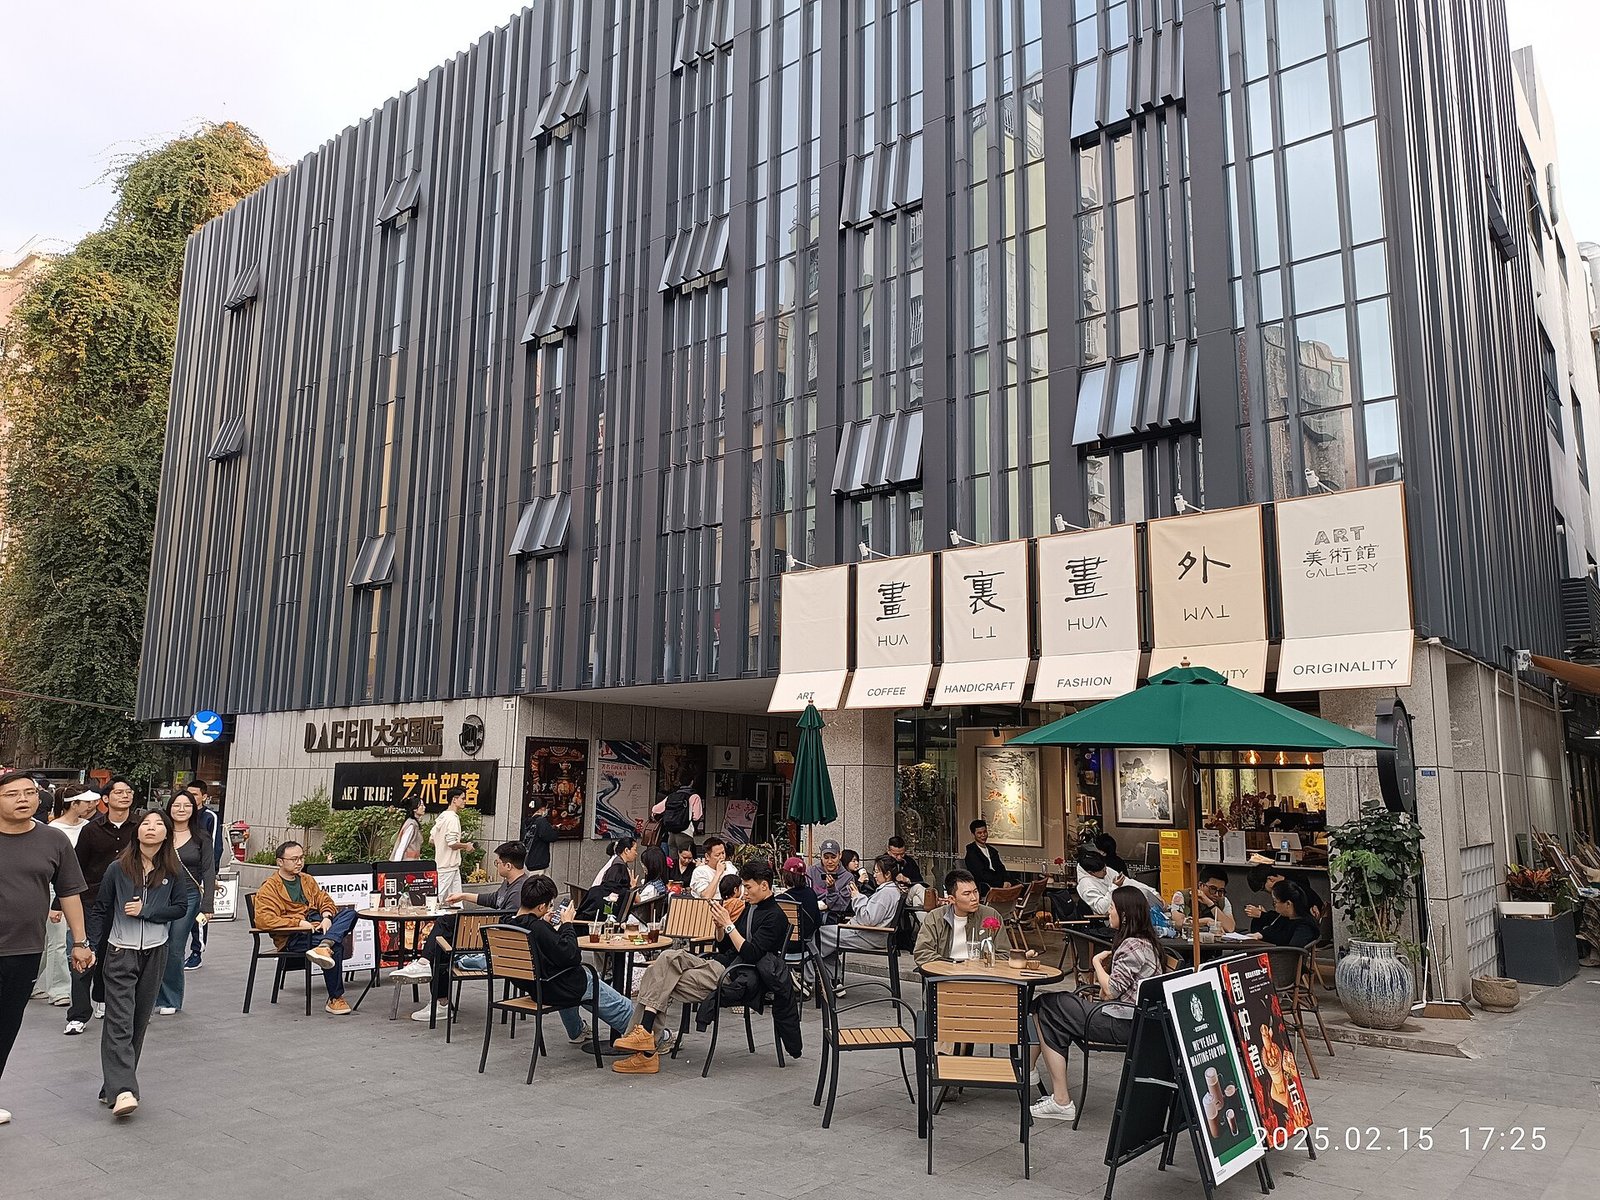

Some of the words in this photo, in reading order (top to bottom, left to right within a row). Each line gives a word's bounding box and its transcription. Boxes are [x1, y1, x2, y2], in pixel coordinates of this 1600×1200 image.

[1314, 526, 1365, 545] ART
[1303, 543, 1379, 567] 美術館
[1177, 546, 1231, 584] 外
[1305, 562, 1379, 578] GALLERY
[1067, 616, 1108, 631] HUA
[877, 634, 909, 647] HUA
[1293, 658, 1398, 675] ORIGINALITY
[944, 681, 1015, 694] HANDICRAFT
[1056, 676, 1112, 688] FASHION
[796, 692, 815, 701] ART
[867, 686, 907, 696] COFFEE
[373, 716, 444, 747] 大芬国际
[383, 746, 425, 755] INTERNATIONAL
[341, 786, 360, 801] ART
[321, 883, 368, 893] MERICAN
